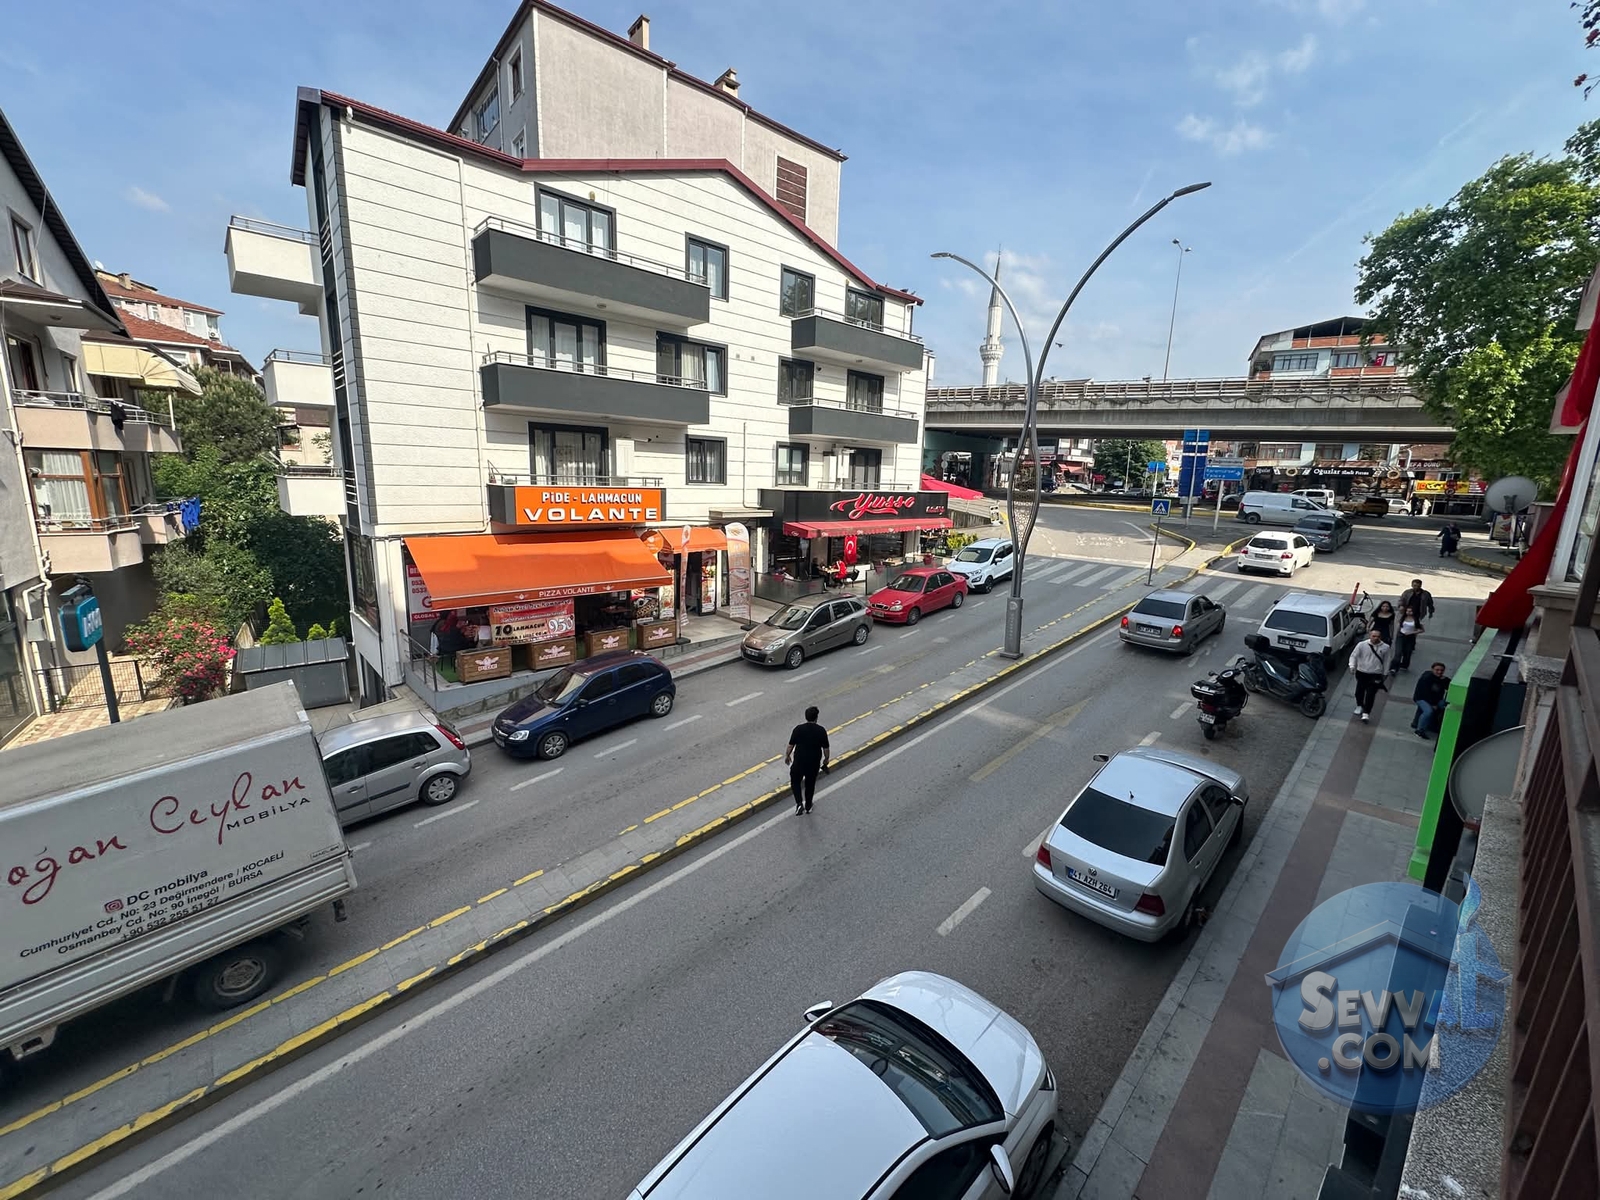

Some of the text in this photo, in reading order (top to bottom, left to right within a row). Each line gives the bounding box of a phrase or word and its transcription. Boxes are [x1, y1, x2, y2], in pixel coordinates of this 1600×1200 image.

[581, 491, 642, 504] LAHMACUN
[523, 508, 658, 522] VOLANTE
[563, 586, 596, 595] VOLANTE
[226, 797, 311, 831] MOBİLYA
[0, 772, 305, 905] oğan Ceylan
[127, 870, 208, 906] DC mobilya
[1084, 875, 1098, 887] AZH
[20, 925, 94, 957] Cumhuriyet
[96, 917, 117, 929] Cd.
[143, 901, 156, 911] 23
[160, 871, 234, 905] Değirmendere
[242, 849, 284, 873] KOCAELİ
[58, 925, 122, 954] Osmanbey
[125, 916, 145, 928] Cd.
[148, 907, 168, 919] No:
[171, 900, 184, 910] 90
[228, 869, 264, 888] BURSA
[147, 917, 166, 930] 532
[207, 896, 220, 907] 27
